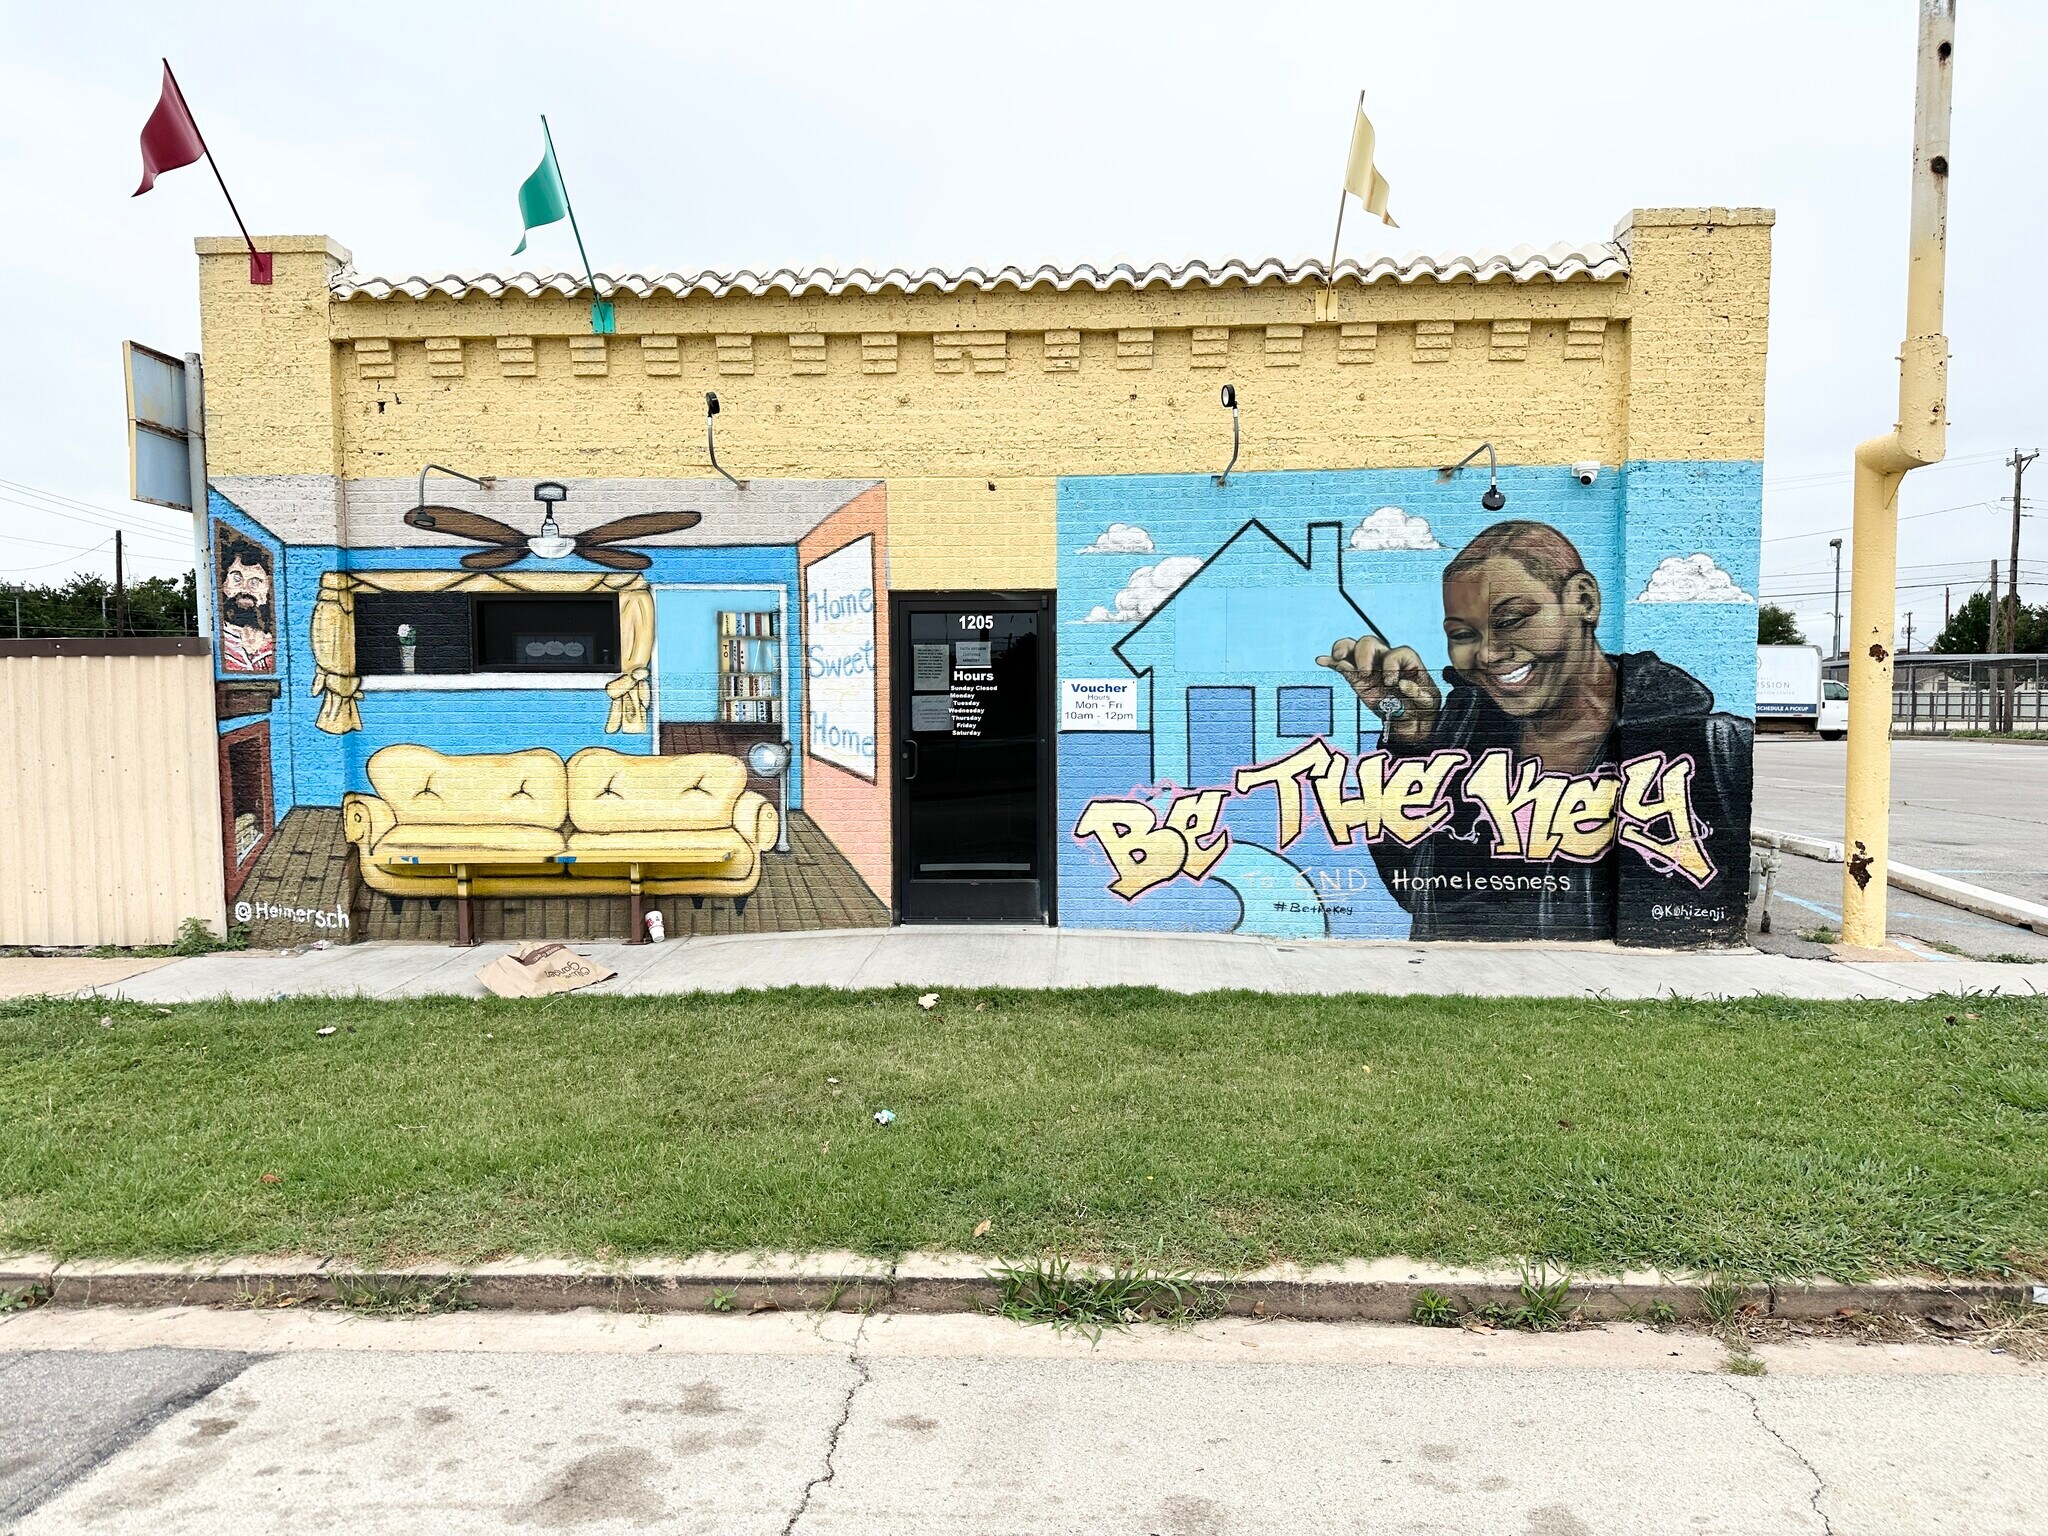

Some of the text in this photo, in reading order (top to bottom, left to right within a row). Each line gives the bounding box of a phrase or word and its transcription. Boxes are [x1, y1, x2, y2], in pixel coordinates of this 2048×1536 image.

[807, 588, 874, 623] Home
[959, 615, 994, 630] 1205
[808, 640, 874, 678] Sweet
[953, 671, 994, 681] Hours
[1071, 683, 1128, 693] Voucher
[1757, 681, 1790, 689] ISSION
[1075, 701, 1098, 709] Mon
[1108, 701, 1122, 709] Fri
[1065, 711, 1094, 720] 10am
[1105, 711, 1133, 721] 12pm
[811, 711, 874, 757] Home
[1392, 868, 1571, 891] Homelessness
